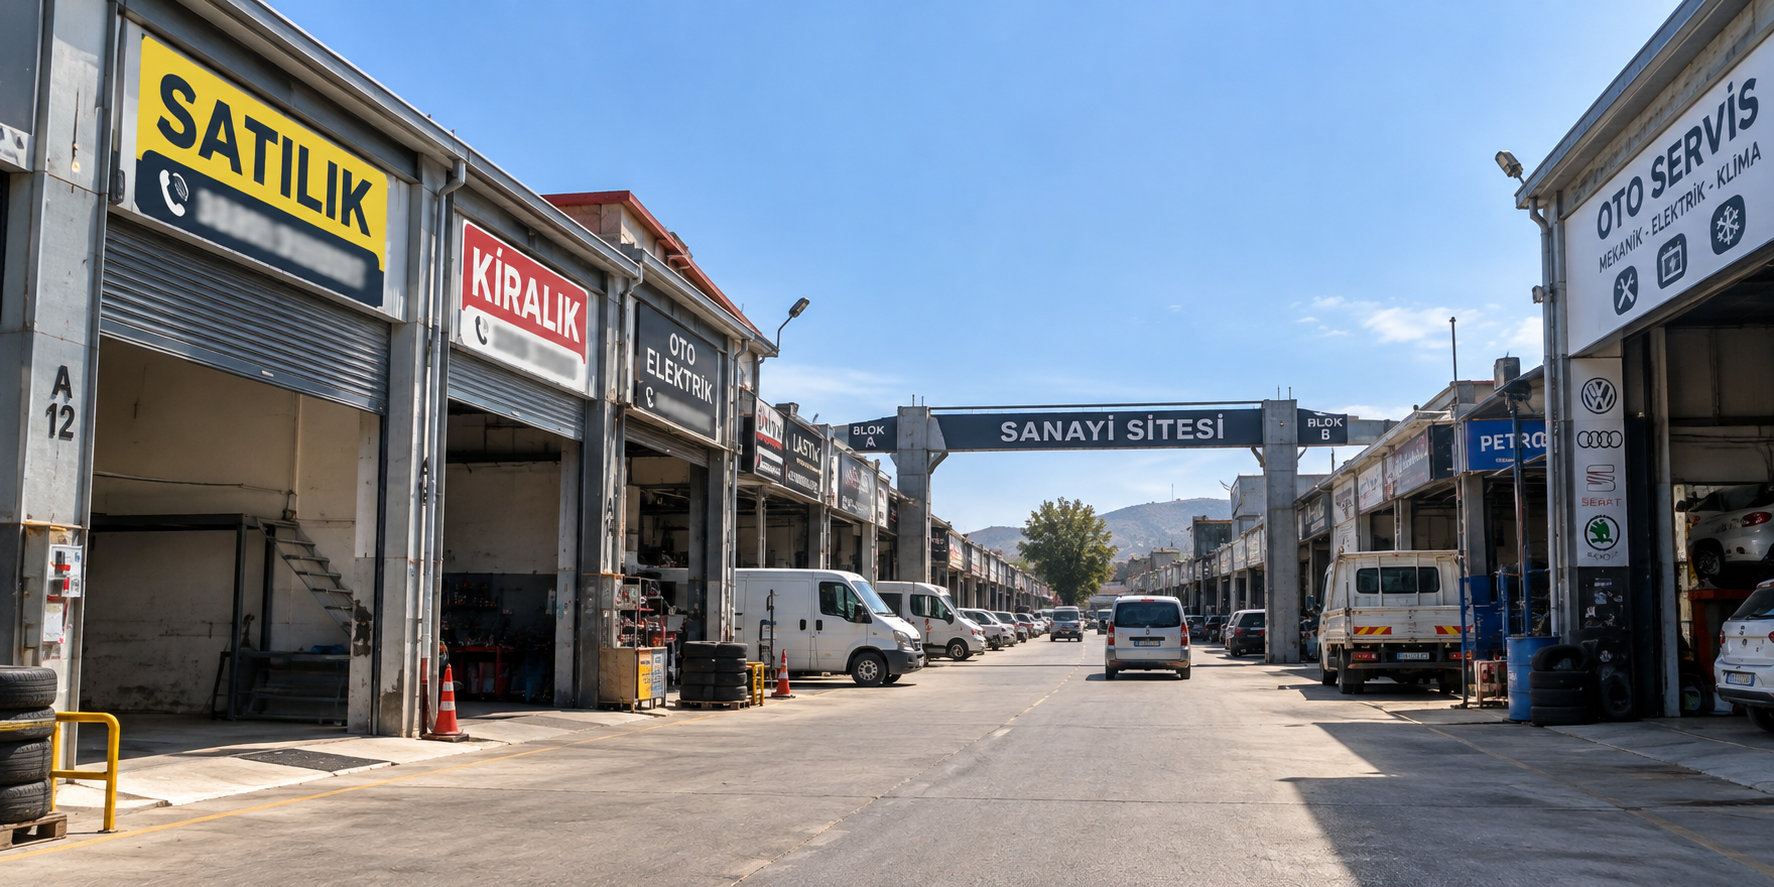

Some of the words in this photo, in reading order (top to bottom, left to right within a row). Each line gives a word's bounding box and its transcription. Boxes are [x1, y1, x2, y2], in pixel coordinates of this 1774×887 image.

[157, 73, 372, 238] SATILIK
[1597, 175, 1644, 240] OTO
[1651, 78, 1759, 199] SERVİS
[1599, 226, 1643, 273] MEKANİK
[1652, 180, 1706, 236] ELEKTRİK
[1717, 141, 1762, 189] KLİMA
[472, 248, 580, 343] KİRALIK
[669, 332, 696, 366] OTO
[52, 365, 73, 400] A
[646, 347, 713, 404] ELEKTRİK
[45, 403, 75, 440] 12
[853, 425, 885, 435] BLOK
[1000, 414, 1115, 442] SANAYİ
[1127, 413, 1225, 440] SİTESİ
[1321, 429, 1330, 440] B
[865, 436, 877, 448] A
